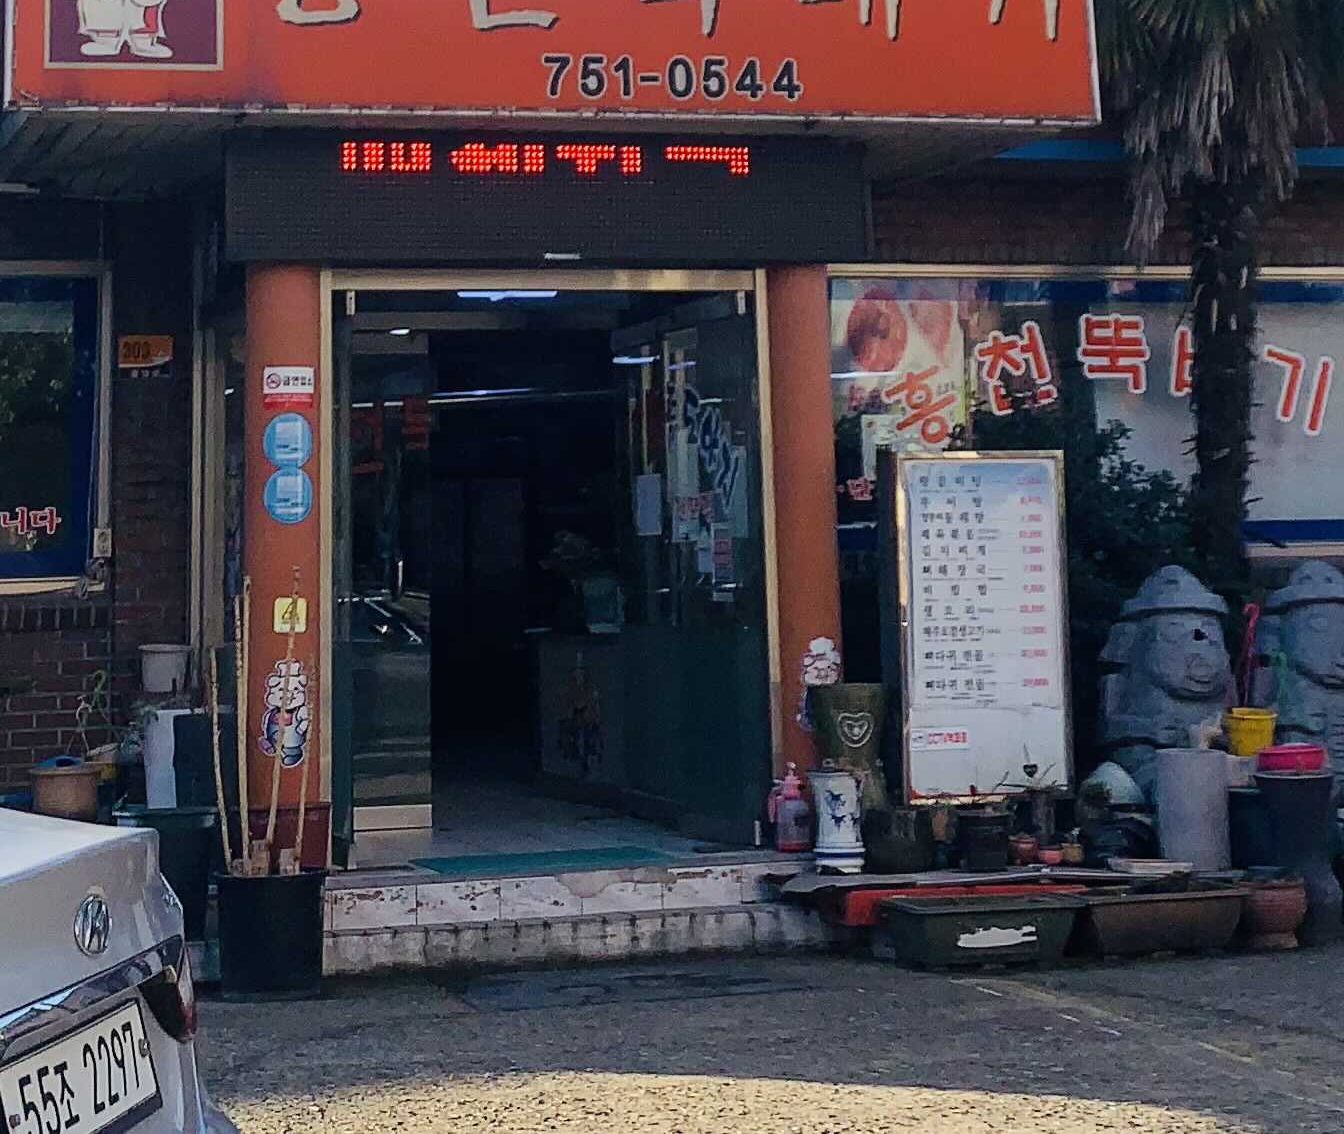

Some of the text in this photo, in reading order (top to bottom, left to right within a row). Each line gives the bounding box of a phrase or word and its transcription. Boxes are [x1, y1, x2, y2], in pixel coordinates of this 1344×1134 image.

[543, 54, 803, 102] 751-0544
[882, 312, 1334, 446] 홍천뚝기
[82, 1021, 139, 1114] 2297
